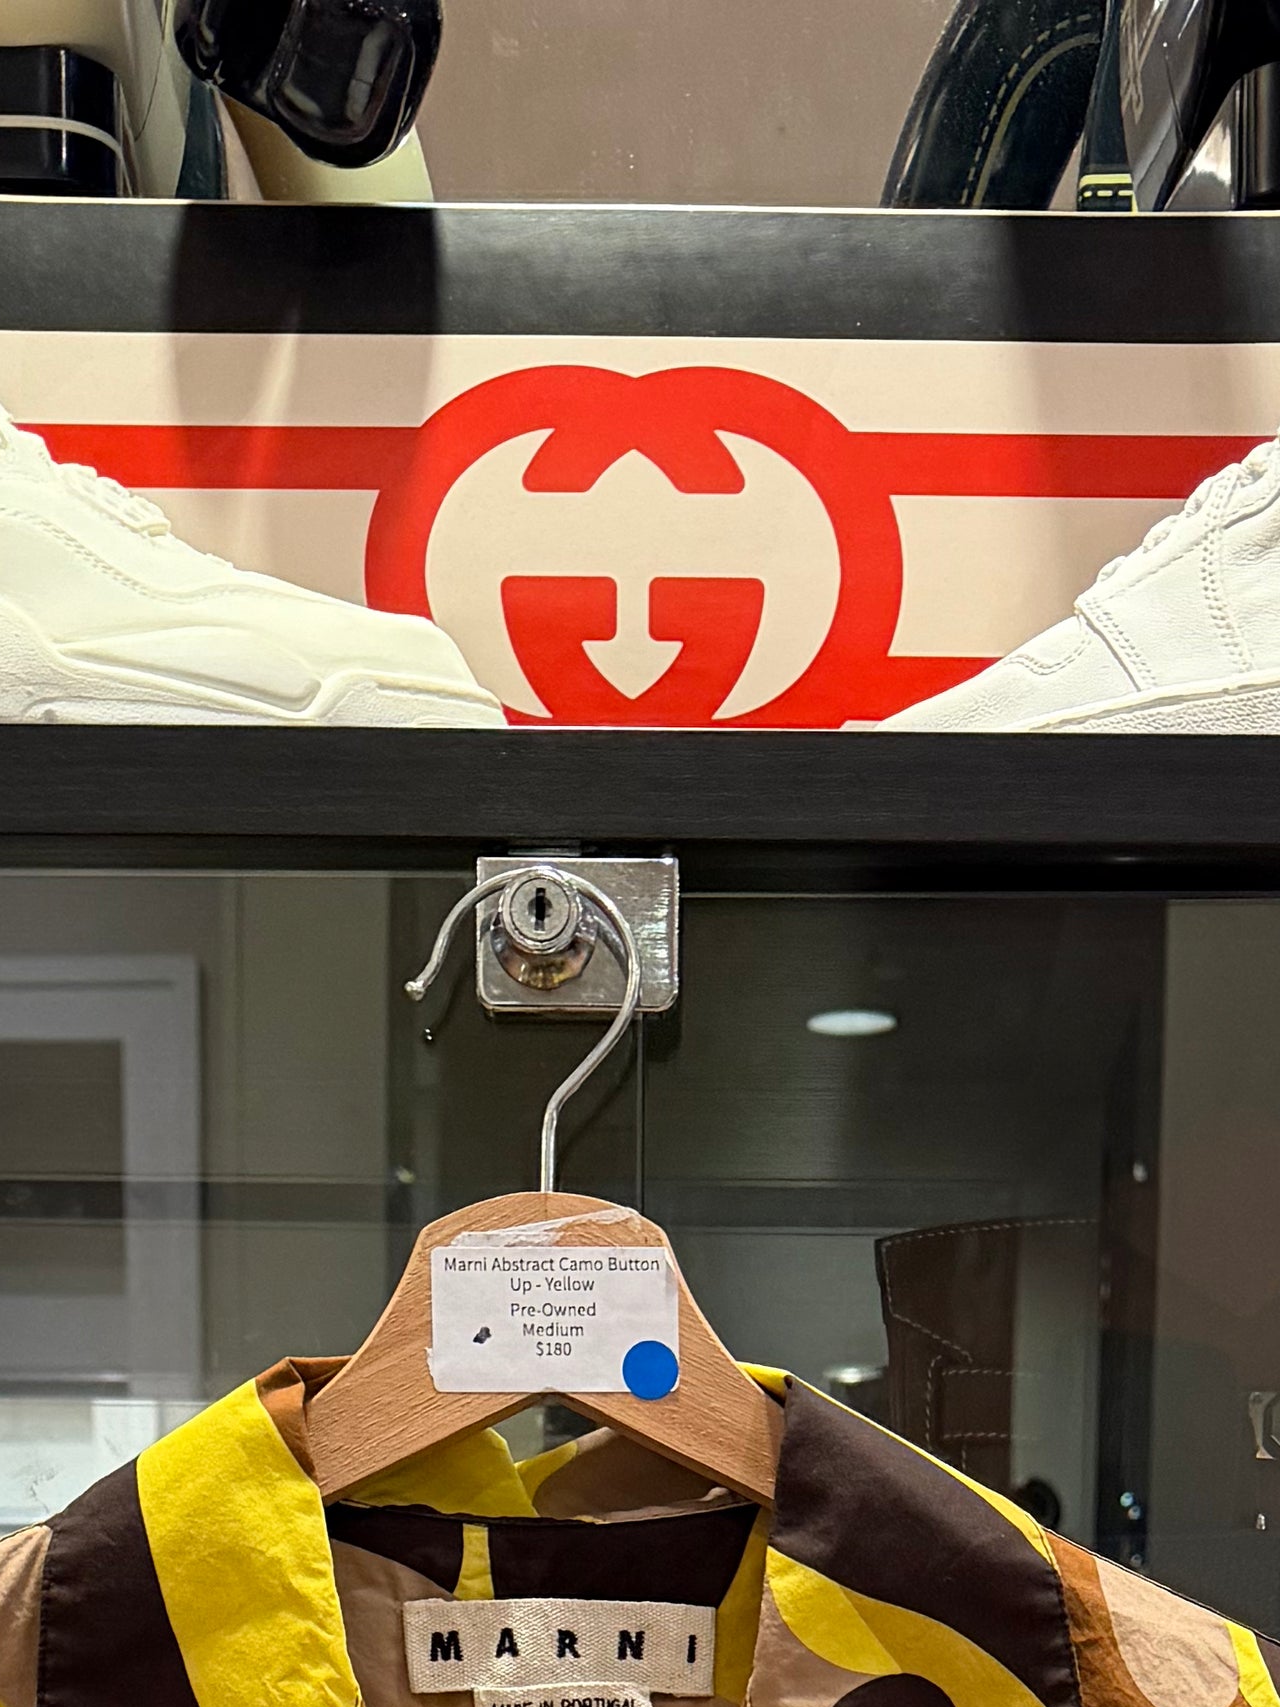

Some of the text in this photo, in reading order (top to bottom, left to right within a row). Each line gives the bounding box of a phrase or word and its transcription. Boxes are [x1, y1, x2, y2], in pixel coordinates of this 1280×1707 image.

[444, 1256, 660, 1272] Marni Abstract Camo Button
[510, 1278, 532, 1295] Up
[545, 1277, 595, 1292] Yellow
[510, 1303, 596, 1318] Pre-Owned
[522, 1323, 584, 1337] Medium
[535, 1341, 572, 1357] $180
[430, 1627, 697, 1664] MARNI
